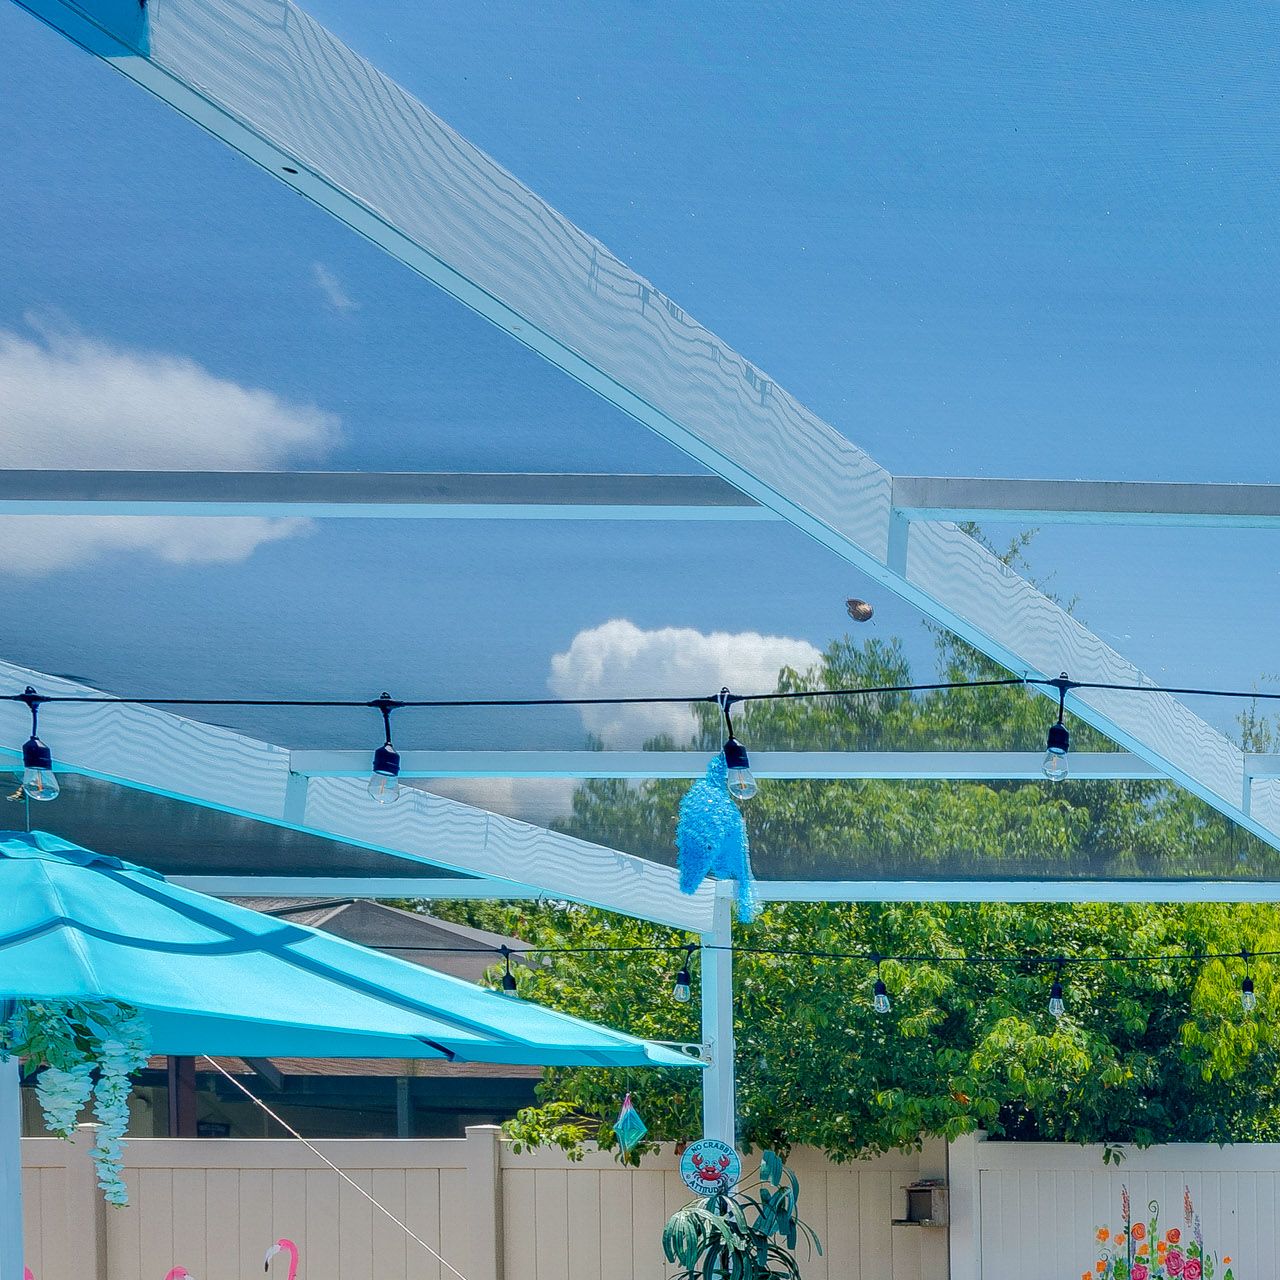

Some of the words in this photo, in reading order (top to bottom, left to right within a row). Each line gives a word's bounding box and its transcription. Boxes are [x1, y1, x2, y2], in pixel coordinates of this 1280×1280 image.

[691, 1143, 702, 1154] NO
[703, 1142, 734, 1156] CRABBY
[688, 1180, 720, 1194] ATTITUD
